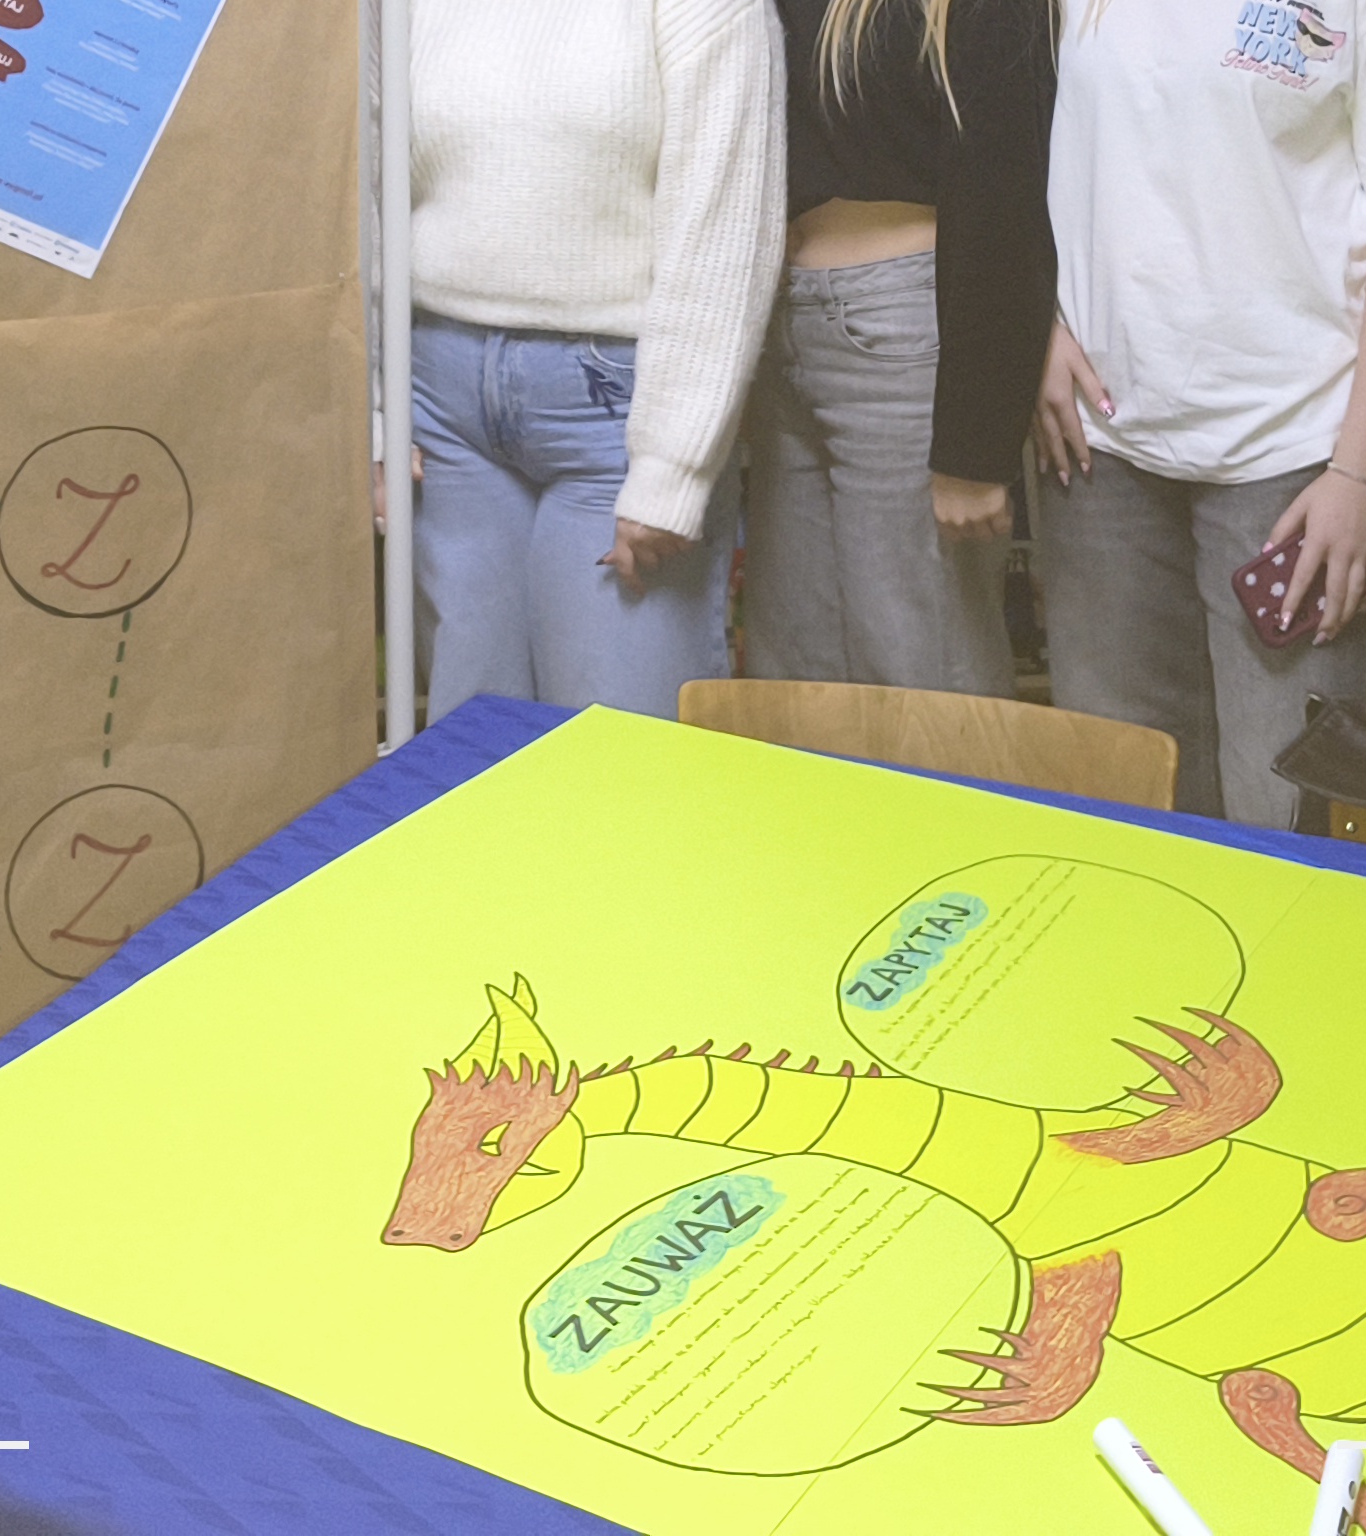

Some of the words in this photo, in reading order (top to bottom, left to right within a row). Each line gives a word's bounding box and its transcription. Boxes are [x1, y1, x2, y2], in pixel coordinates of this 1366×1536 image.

[1235, 28, 1308, 77] YORK
[1237, 0, 1297, 41] NEW
[844, 901, 972, 1003] ZAPYTAJ
[547, 1189, 765, 1354] ZAUWAŻ
